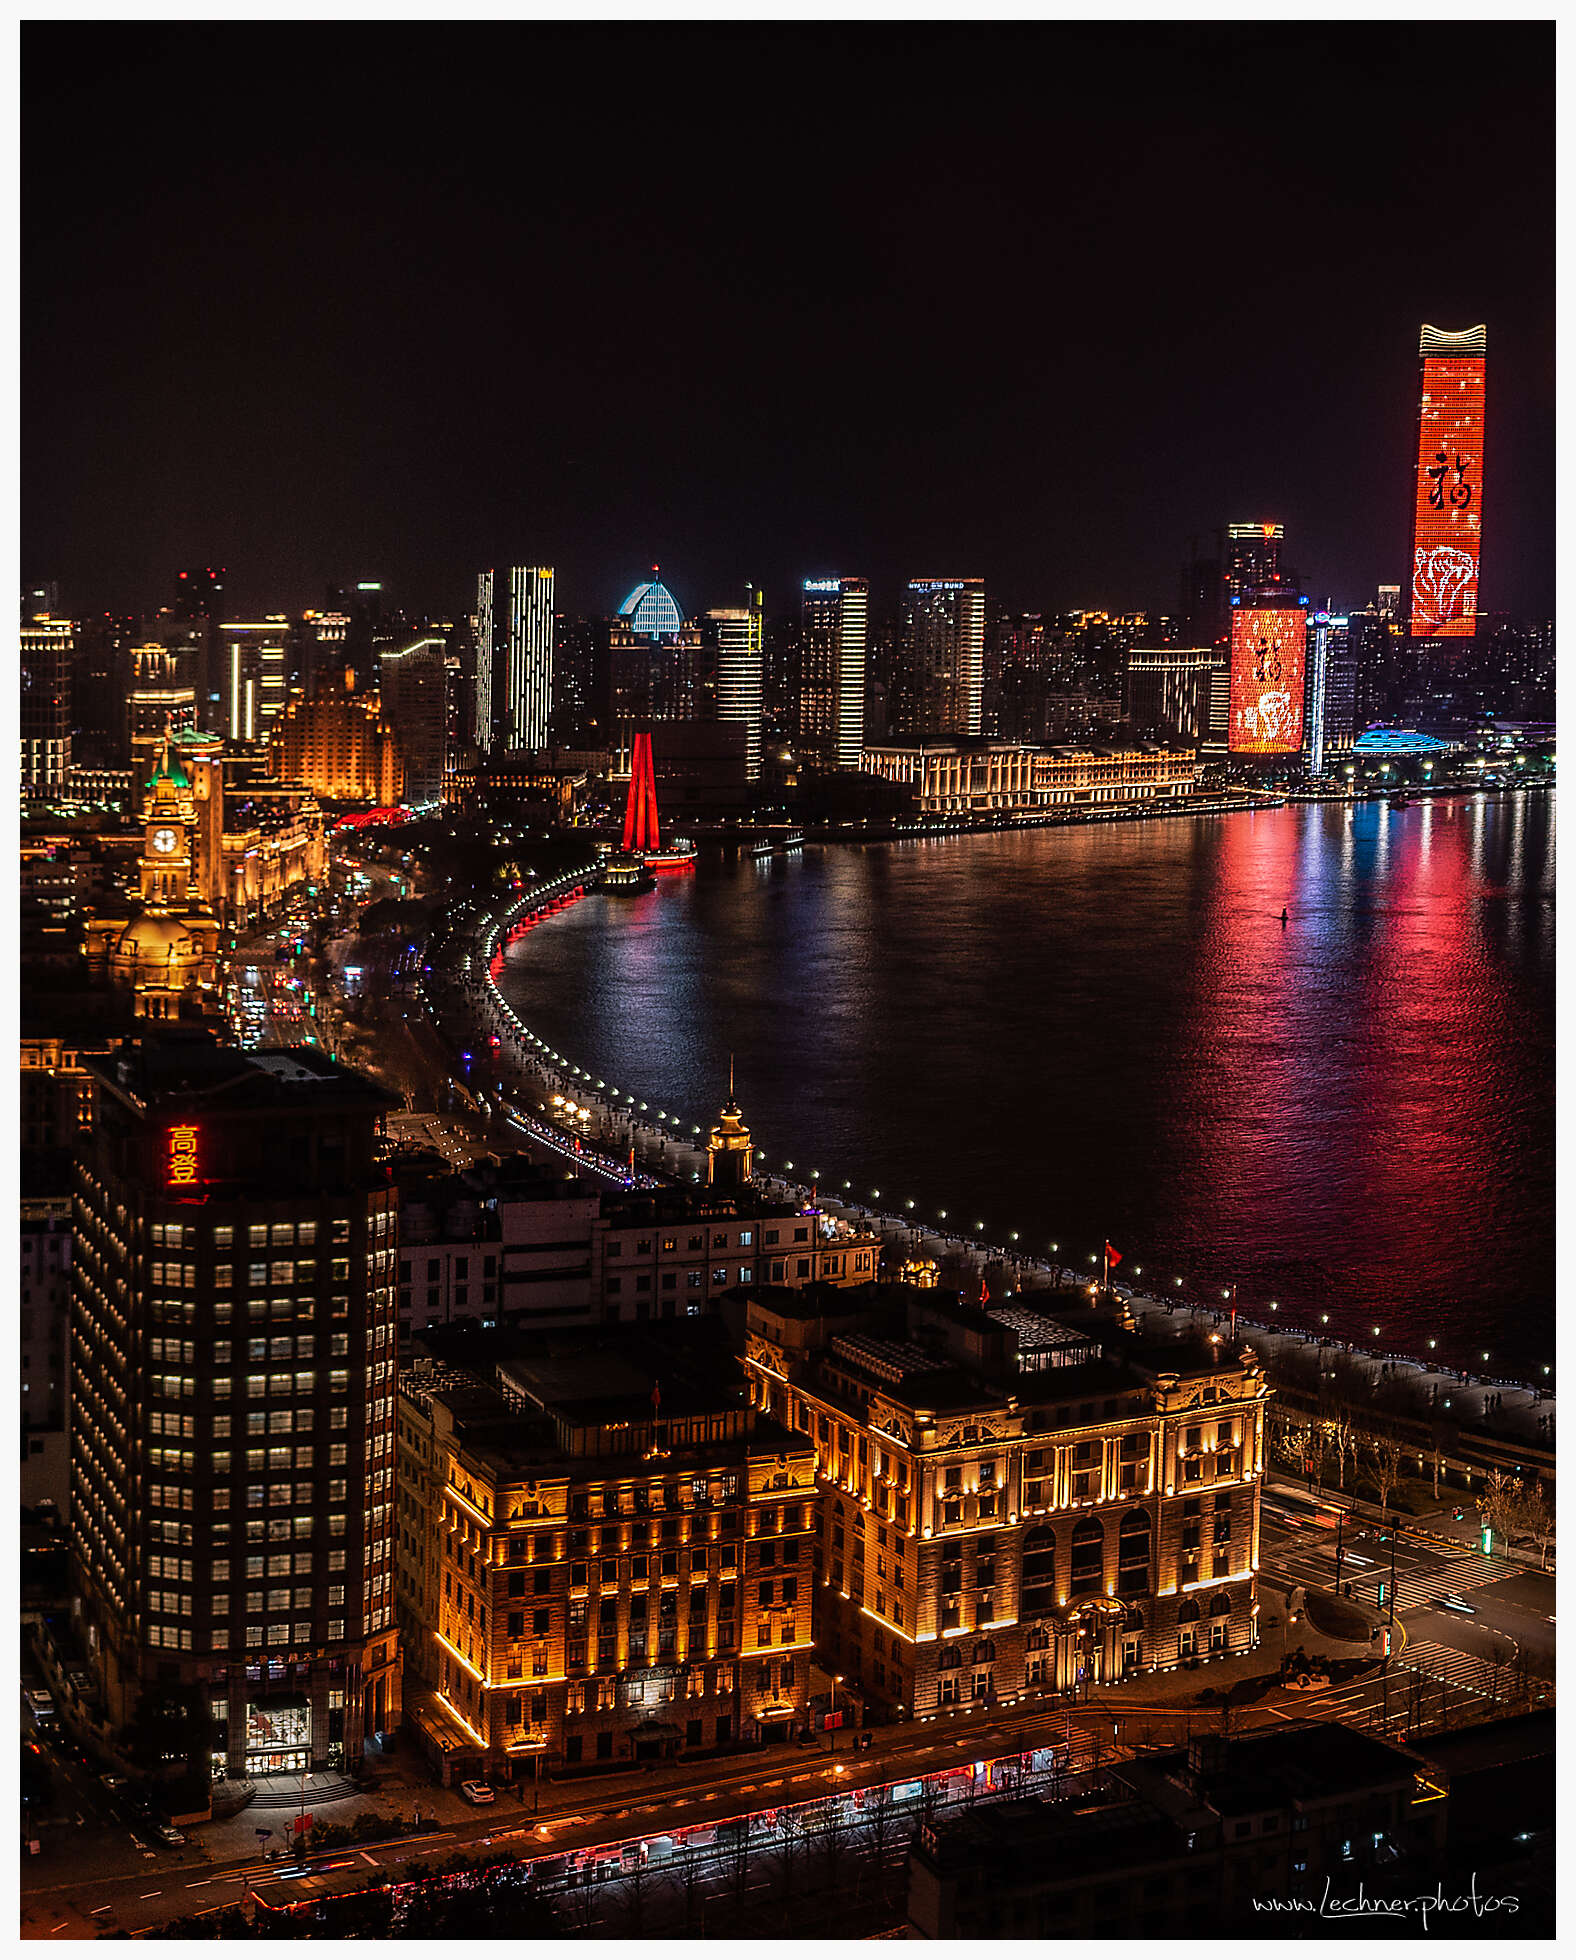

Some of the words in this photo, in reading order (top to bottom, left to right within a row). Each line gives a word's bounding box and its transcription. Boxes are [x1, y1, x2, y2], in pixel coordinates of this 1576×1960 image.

[1428, 452, 1472, 510] 福
[1263, 525, 1275, 537] W
[908, 582, 929, 590] HYATT
[168, 1124, 199, 1184] 高登
